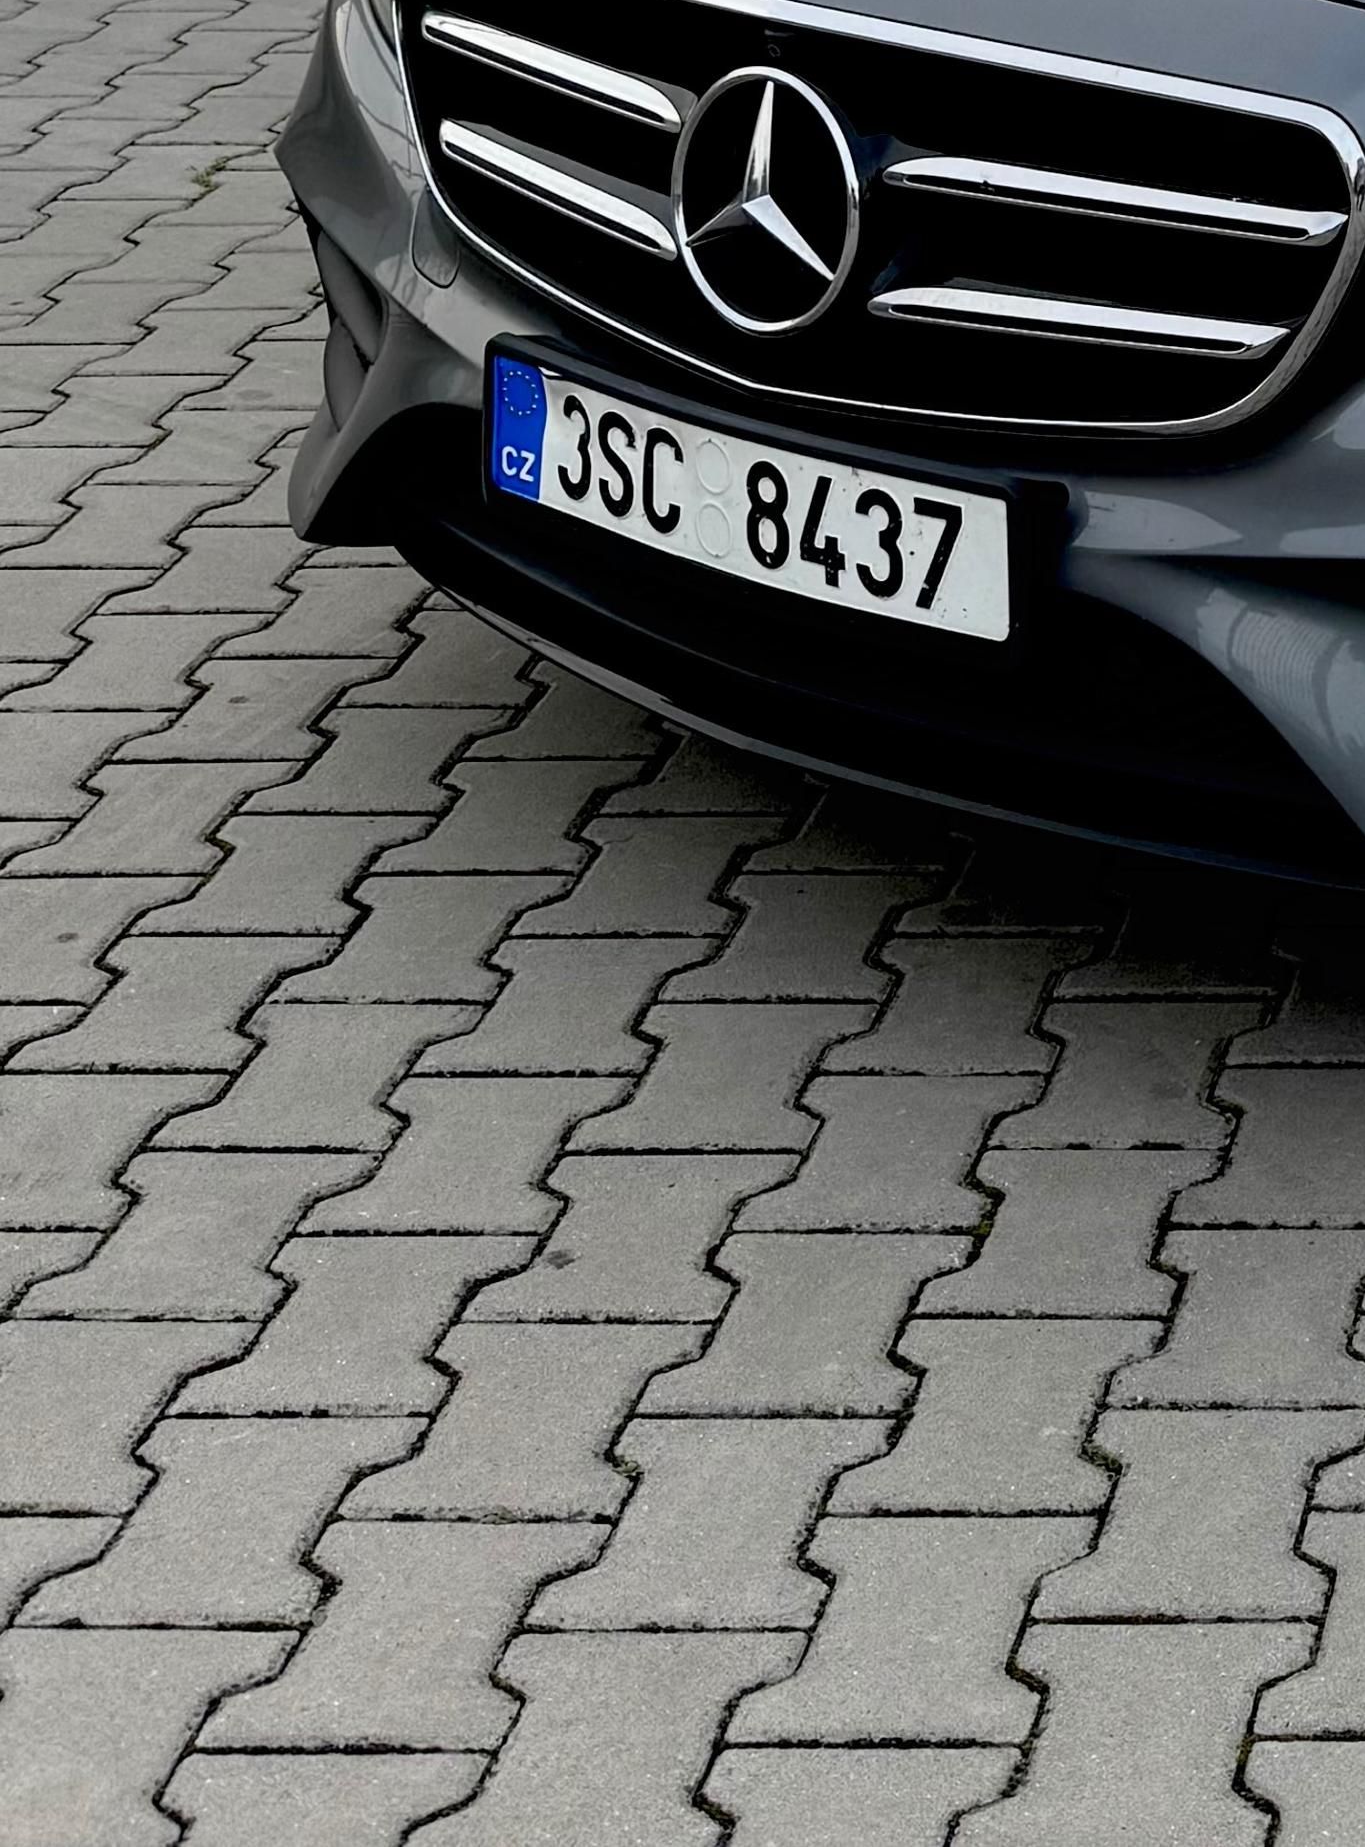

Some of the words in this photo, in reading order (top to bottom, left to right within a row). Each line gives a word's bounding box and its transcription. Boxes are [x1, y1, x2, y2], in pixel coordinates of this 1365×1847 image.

[502, 445, 536, 482] CZ
[557, 394, 684, 534] 3SC
[746, 460, 963, 610] 8437
